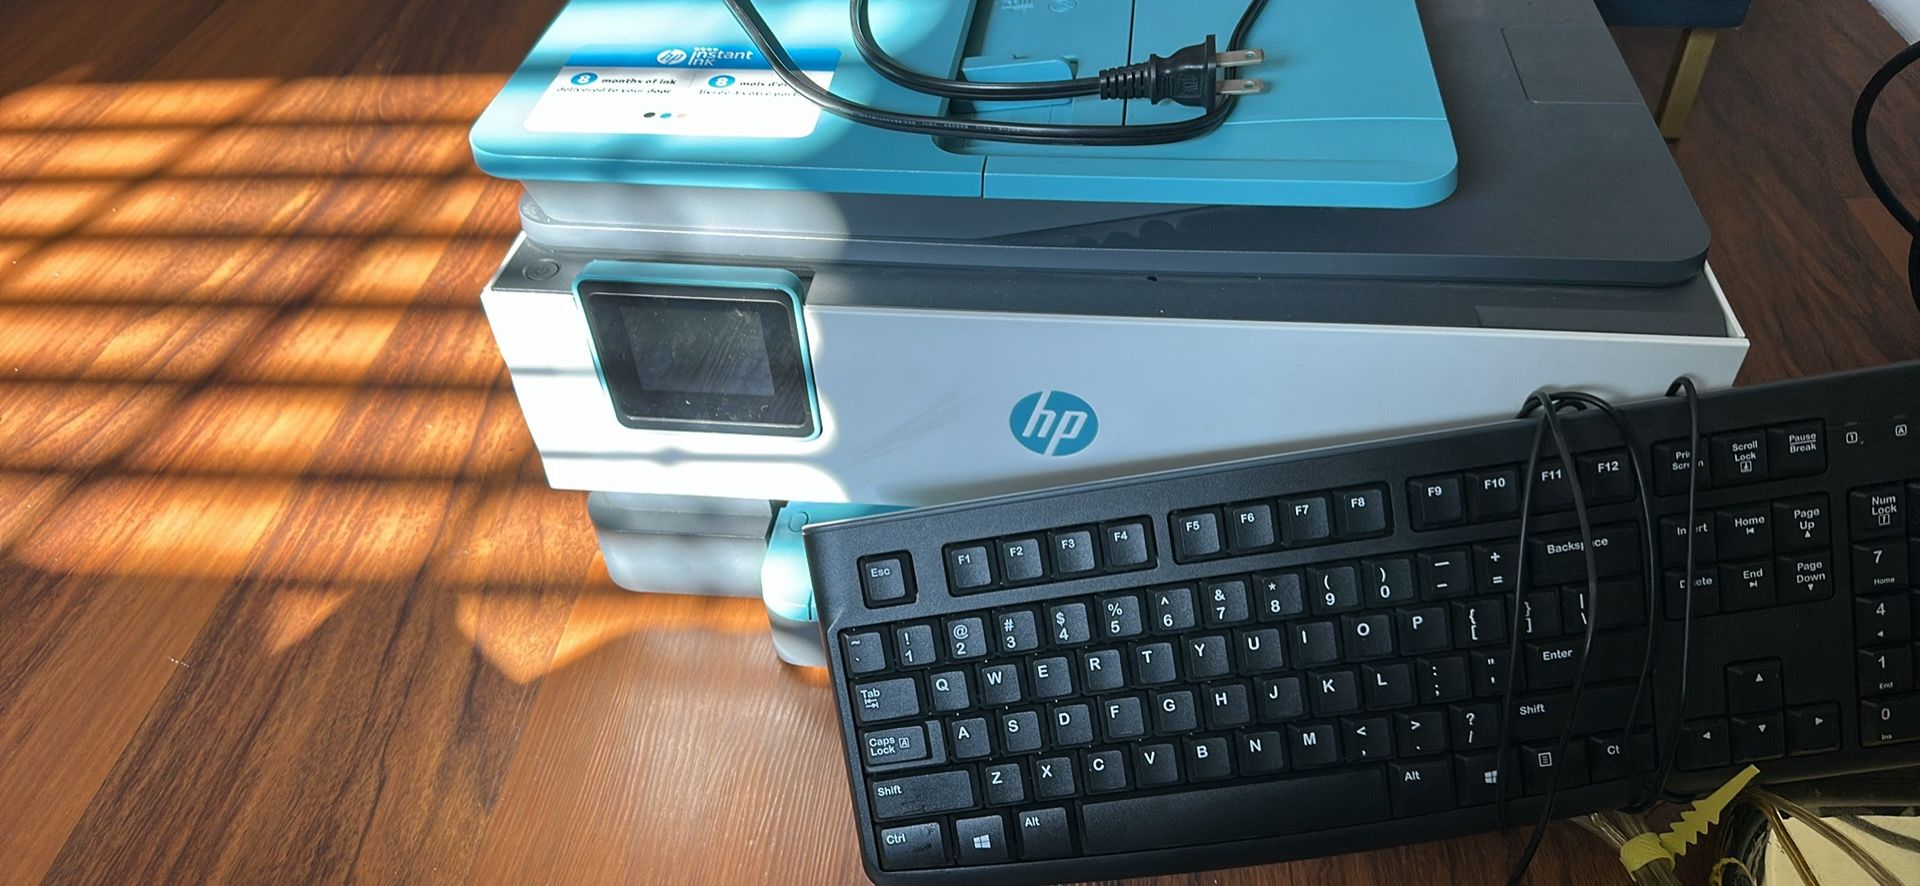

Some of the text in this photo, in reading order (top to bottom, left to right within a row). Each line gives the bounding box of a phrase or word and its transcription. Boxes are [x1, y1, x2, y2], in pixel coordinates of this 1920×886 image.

[688, 47, 754, 65] instant
[1789, 434, 1816, 444] Pause
[1733, 441, 1757, 451] Scroll
[1790, 443, 1816, 453] Break
[1734, 451, 1757, 462] Lock
[1598, 461, 1618, 472] F12
[1542, 470, 1561, 481] F11
[1485, 478, 1505, 489] F10
[1428, 486, 1441, 496] F9
[1351, 497, 1365, 508] F8
[1871, 495, 1896, 506] Num
[1296, 505, 1308, 515] F7
[1793, 508, 1820, 519] Page
[1872, 503, 1896, 517] Lock
[1241, 513, 1254, 523] F6
[1735, 517, 1764, 529] Home
[1186, 521, 1199, 531] F5
[1800, 521, 1814, 533] Up
[1114, 531, 1127, 541] F4
[1062, 539, 1075, 549] F3
[1009, 546, 1024, 557] F2
[1873, 550, 1883, 564] 7
[958, 554, 970, 564] F1
[870, 567, 891, 578] Esc
[1797, 561, 1823, 572] Page
[1744, 569, 1762, 579] End
[1796, 573, 1826, 584] Down
[1873, 577, 1895, 585] Home
[1215, 590, 1225, 601] &
[1380, 585, 1391, 599] 0
[1325, 592, 1336, 606] 9
[1108, 603, 1122, 616] %
[1270, 599, 1281, 613] 8
[1876, 602, 1886, 616] 4
[1055, 611, 1066, 627] $
[1216, 606, 1226, 620] 7
[1004, 619, 1014, 631] #
[1163, 613, 1174, 627] 6
[1412, 615, 1423, 630] P
[954, 625, 968, 639] @
[1110, 620, 1121, 634] 5
[1357, 623, 1369, 636] O
[1058, 627, 1069, 641] 4
[1301, 630, 1307, 644] I
[1006, 635, 1017, 649] 3
[1248, 637, 1259, 650] U
[956, 643, 966, 655] 2
[1194, 643, 1205, 657] Y
[1543, 650, 1572, 660] Enter
[904, 649, 913, 663] 1
[1142, 651, 1152, 663] T
[1878, 655, 1886, 669] 1
[1090, 658, 1101, 670] R
[1038, 665, 1048, 677] E
[987, 671, 1001, 685] W
[1377, 674, 1387, 685] L
[936, 679, 949, 691] Q
[1323, 679, 1335, 692] K
[1879, 681, 1894, 690] End
[860, 688, 880, 698] Tab
[1269, 685, 1278, 699] J
[1164, 699, 1175, 711] G
[1216, 693, 1227, 706] H
[1109, 705, 1119, 719] F
[1520, 704, 1544, 715] Shift
[1881, 707, 1891, 721] 0
[1059, 713, 1070, 725] D
[1465, 712, 1475, 726] ?
[1008, 720, 1018, 732] S
[959, 727, 969, 739] A
[1303, 733, 1316, 745] M
[869, 737, 895, 752] Caps
[871, 745, 895, 756] Lock
[1250, 739, 1261, 752] N
[1144, 751, 1155, 765] V
[1197, 746, 1208, 758] B
[1093, 759, 1104, 770] C
[1042, 765, 1052, 778] X
[1405, 771, 1420, 781] Alt
[992, 772, 1002, 784] Z
[878, 785, 902, 796] Shift
[1025, 817, 1040, 827] Alt
[885, 832, 905, 844] Ctrl
